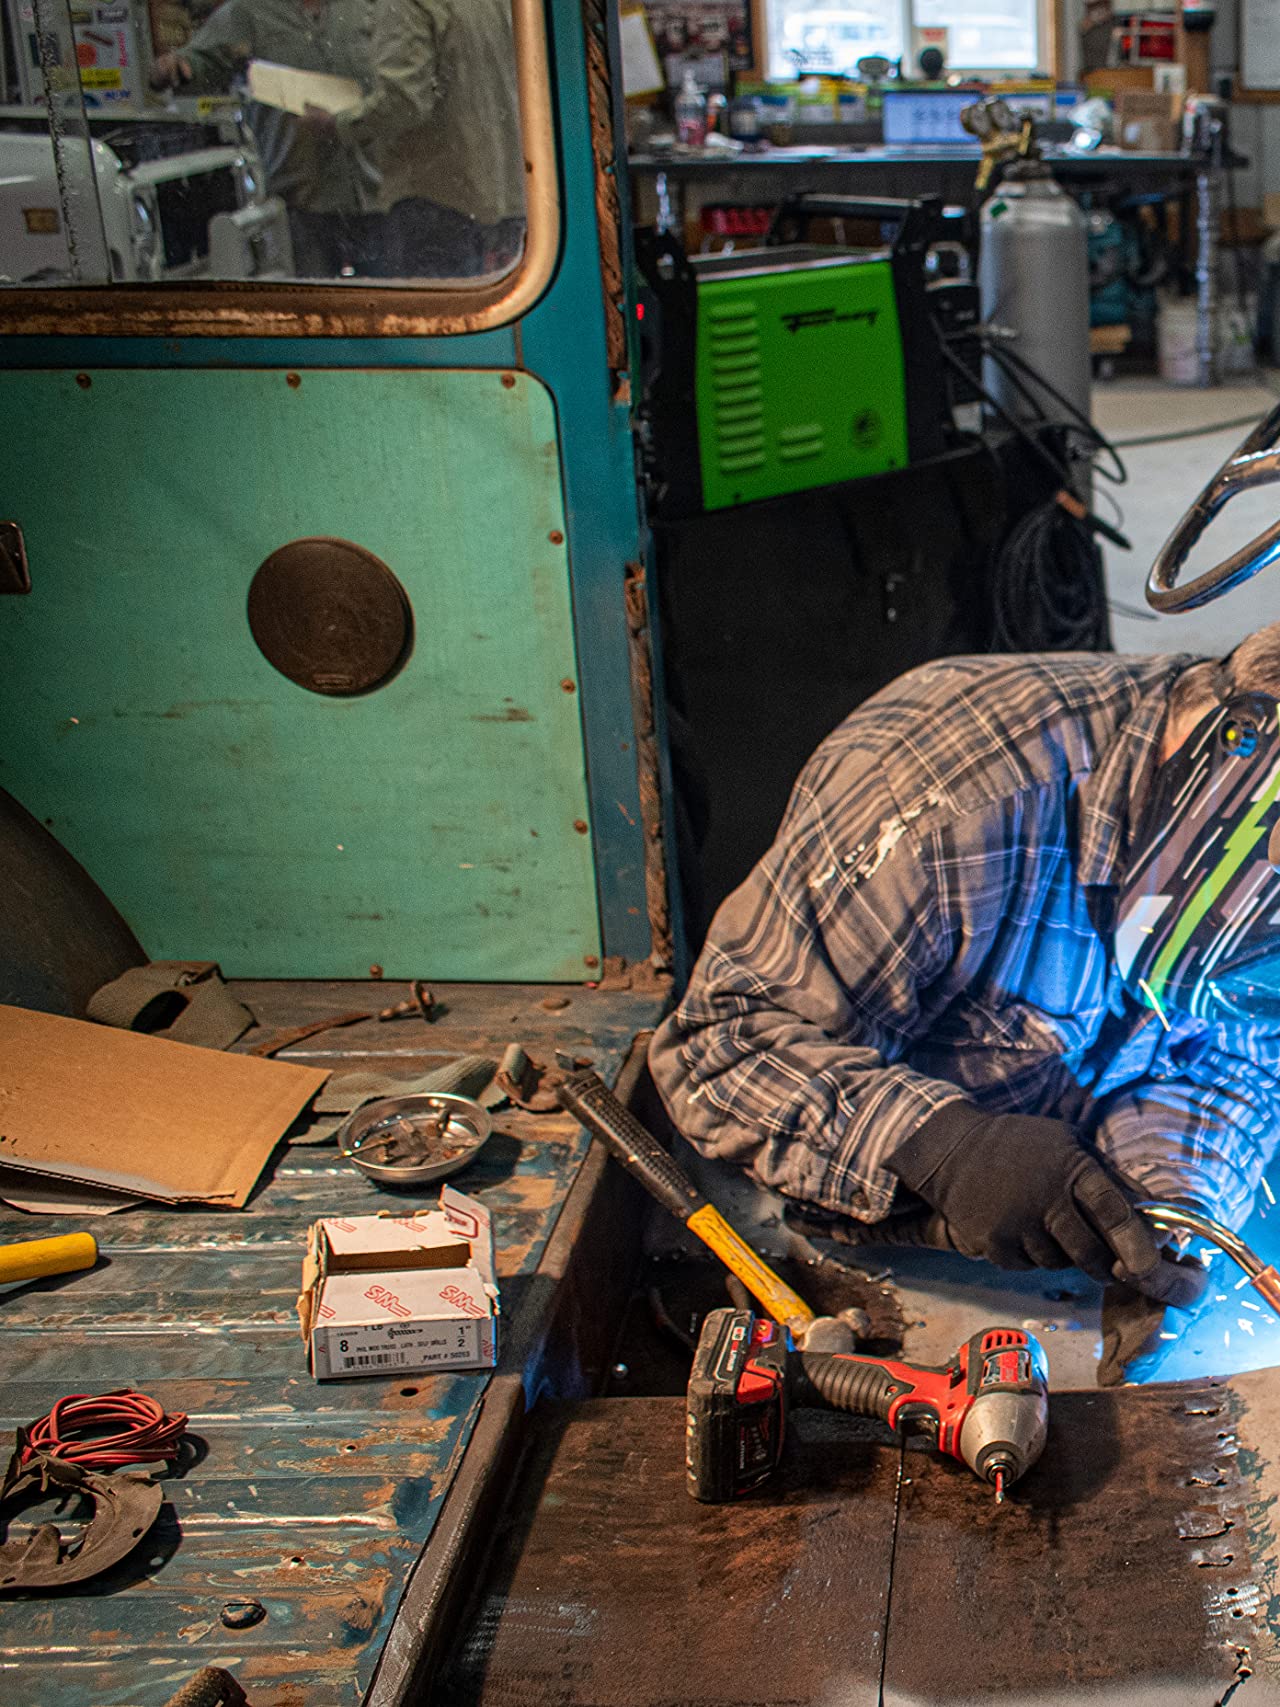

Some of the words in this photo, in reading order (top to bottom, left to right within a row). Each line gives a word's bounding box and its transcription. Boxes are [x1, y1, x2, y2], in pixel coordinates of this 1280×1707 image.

[340, 1340, 349, 1353] 8
[457, 1339, 465, 1348] 2
[423, 1353, 442, 1361] PART
